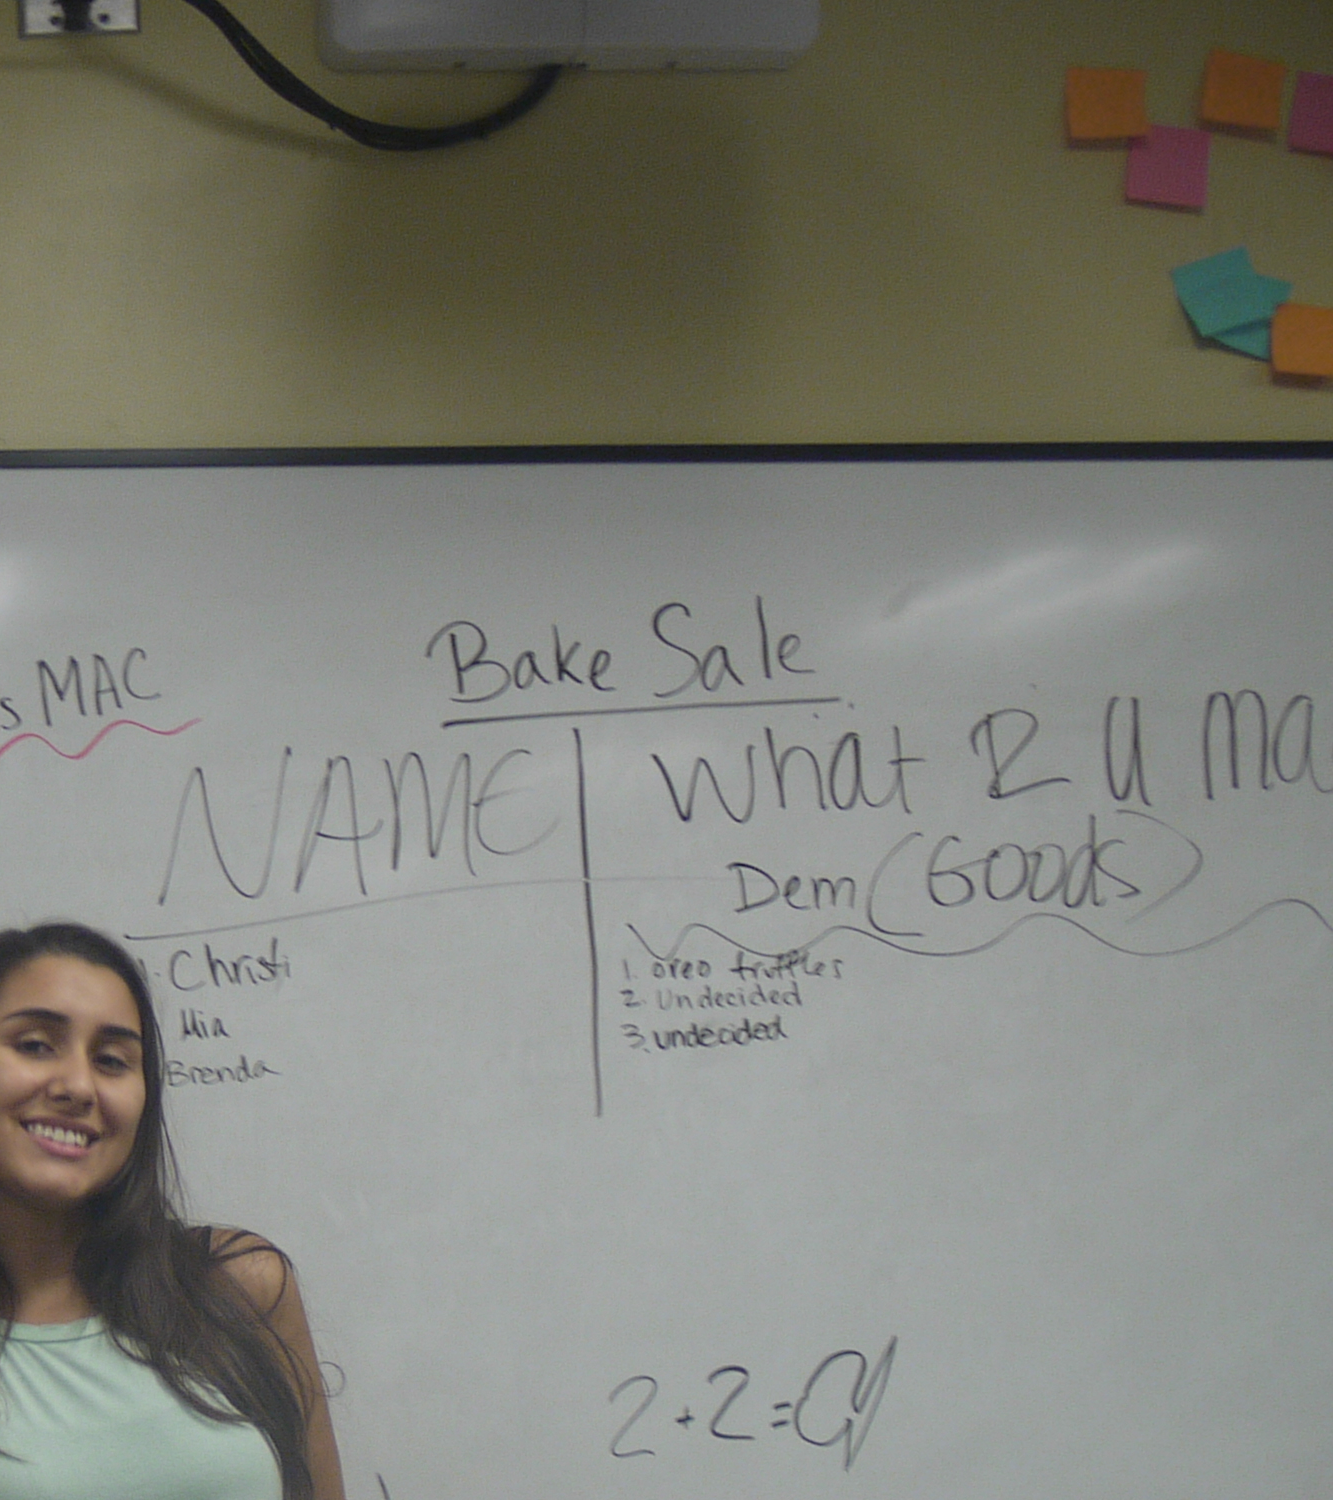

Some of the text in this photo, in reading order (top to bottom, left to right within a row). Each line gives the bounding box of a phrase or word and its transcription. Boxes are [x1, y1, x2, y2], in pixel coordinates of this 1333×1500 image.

[427, 596, 816, 707] Bake Sale
[651, 710, 927, 824] What
[156, 745, 561, 907] NAME
[730, 860, 858, 917] Dem
[653, 957, 712, 981] oreo
[166, 1053, 282, 1088] Brenda
